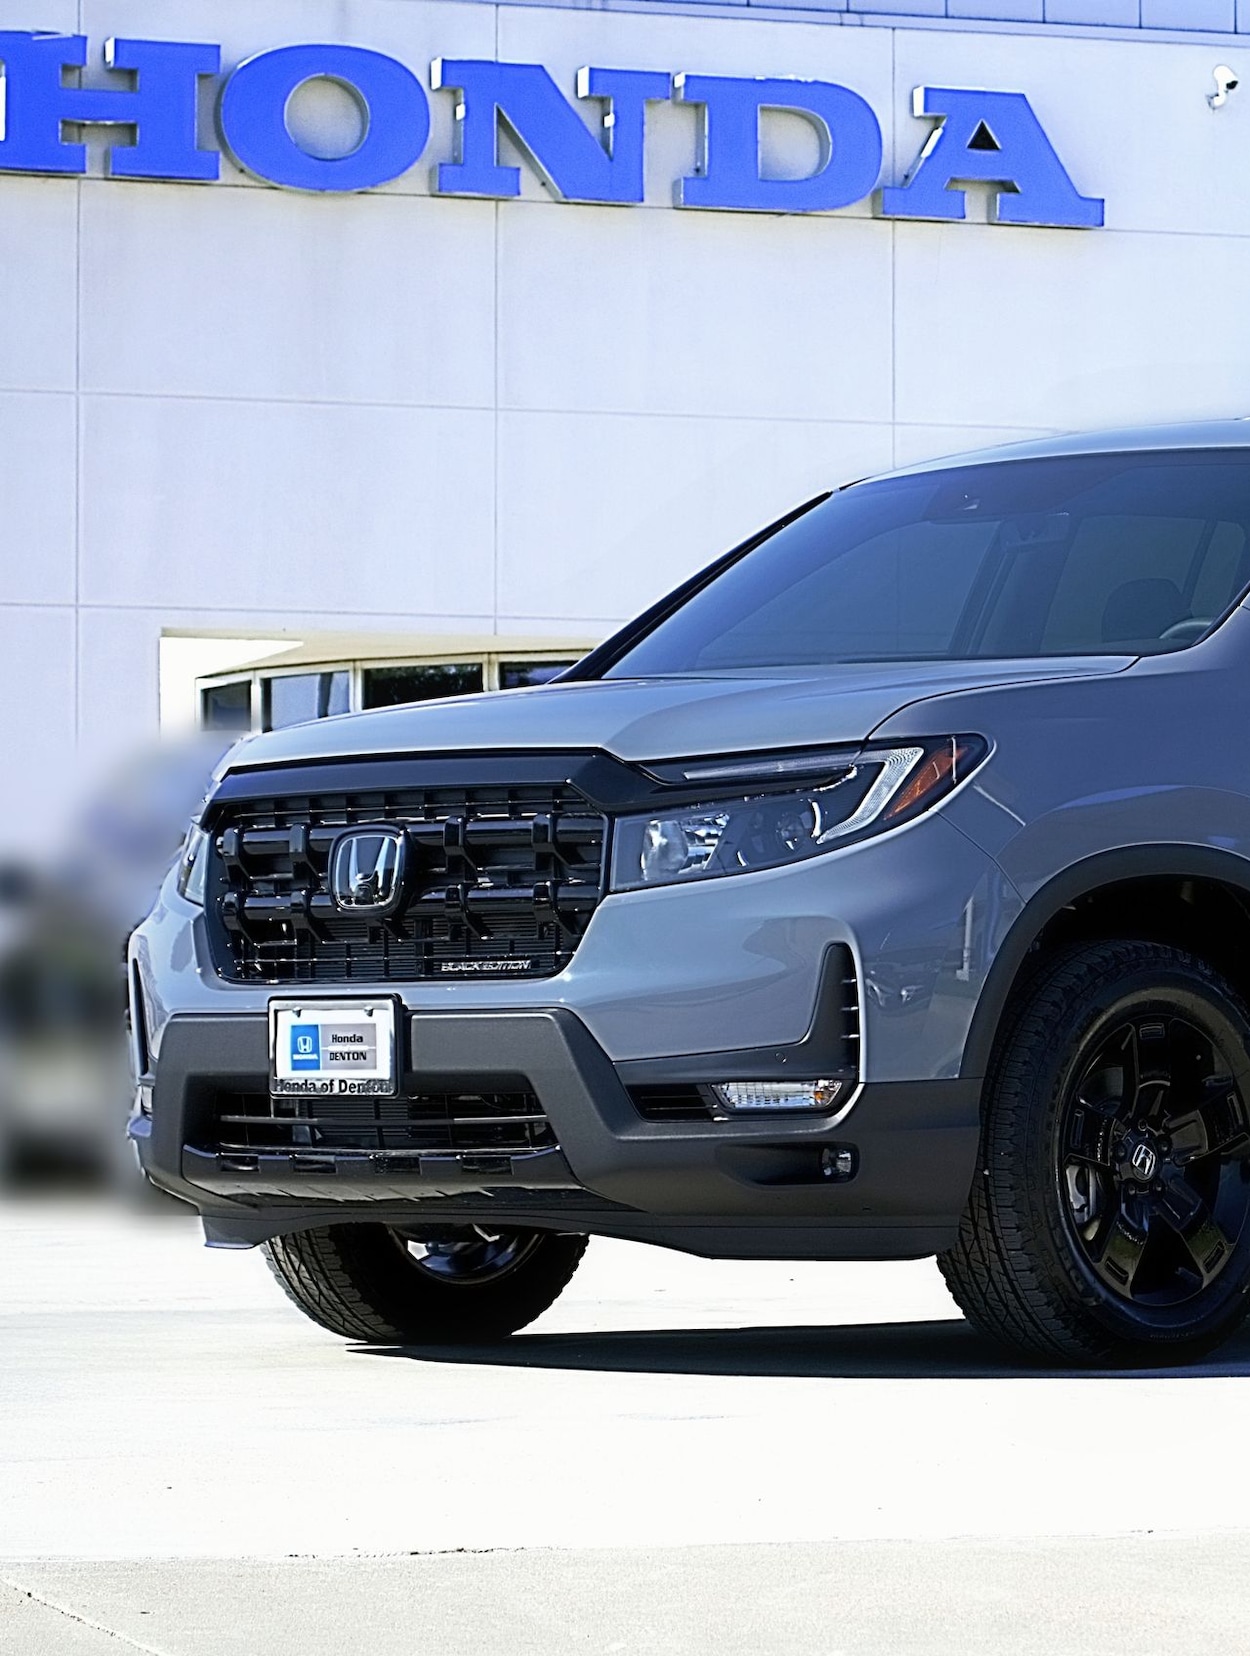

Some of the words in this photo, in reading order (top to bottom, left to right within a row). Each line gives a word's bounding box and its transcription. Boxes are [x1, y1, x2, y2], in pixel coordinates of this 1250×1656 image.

[0, 30, 1105, 228] HONDA
[441, 961, 482, 972] BLACK
[331, 1033, 364, 1043] Honda
[329, 1051, 367, 1061] DENTON
[320, 1079, 335, 1093] of
